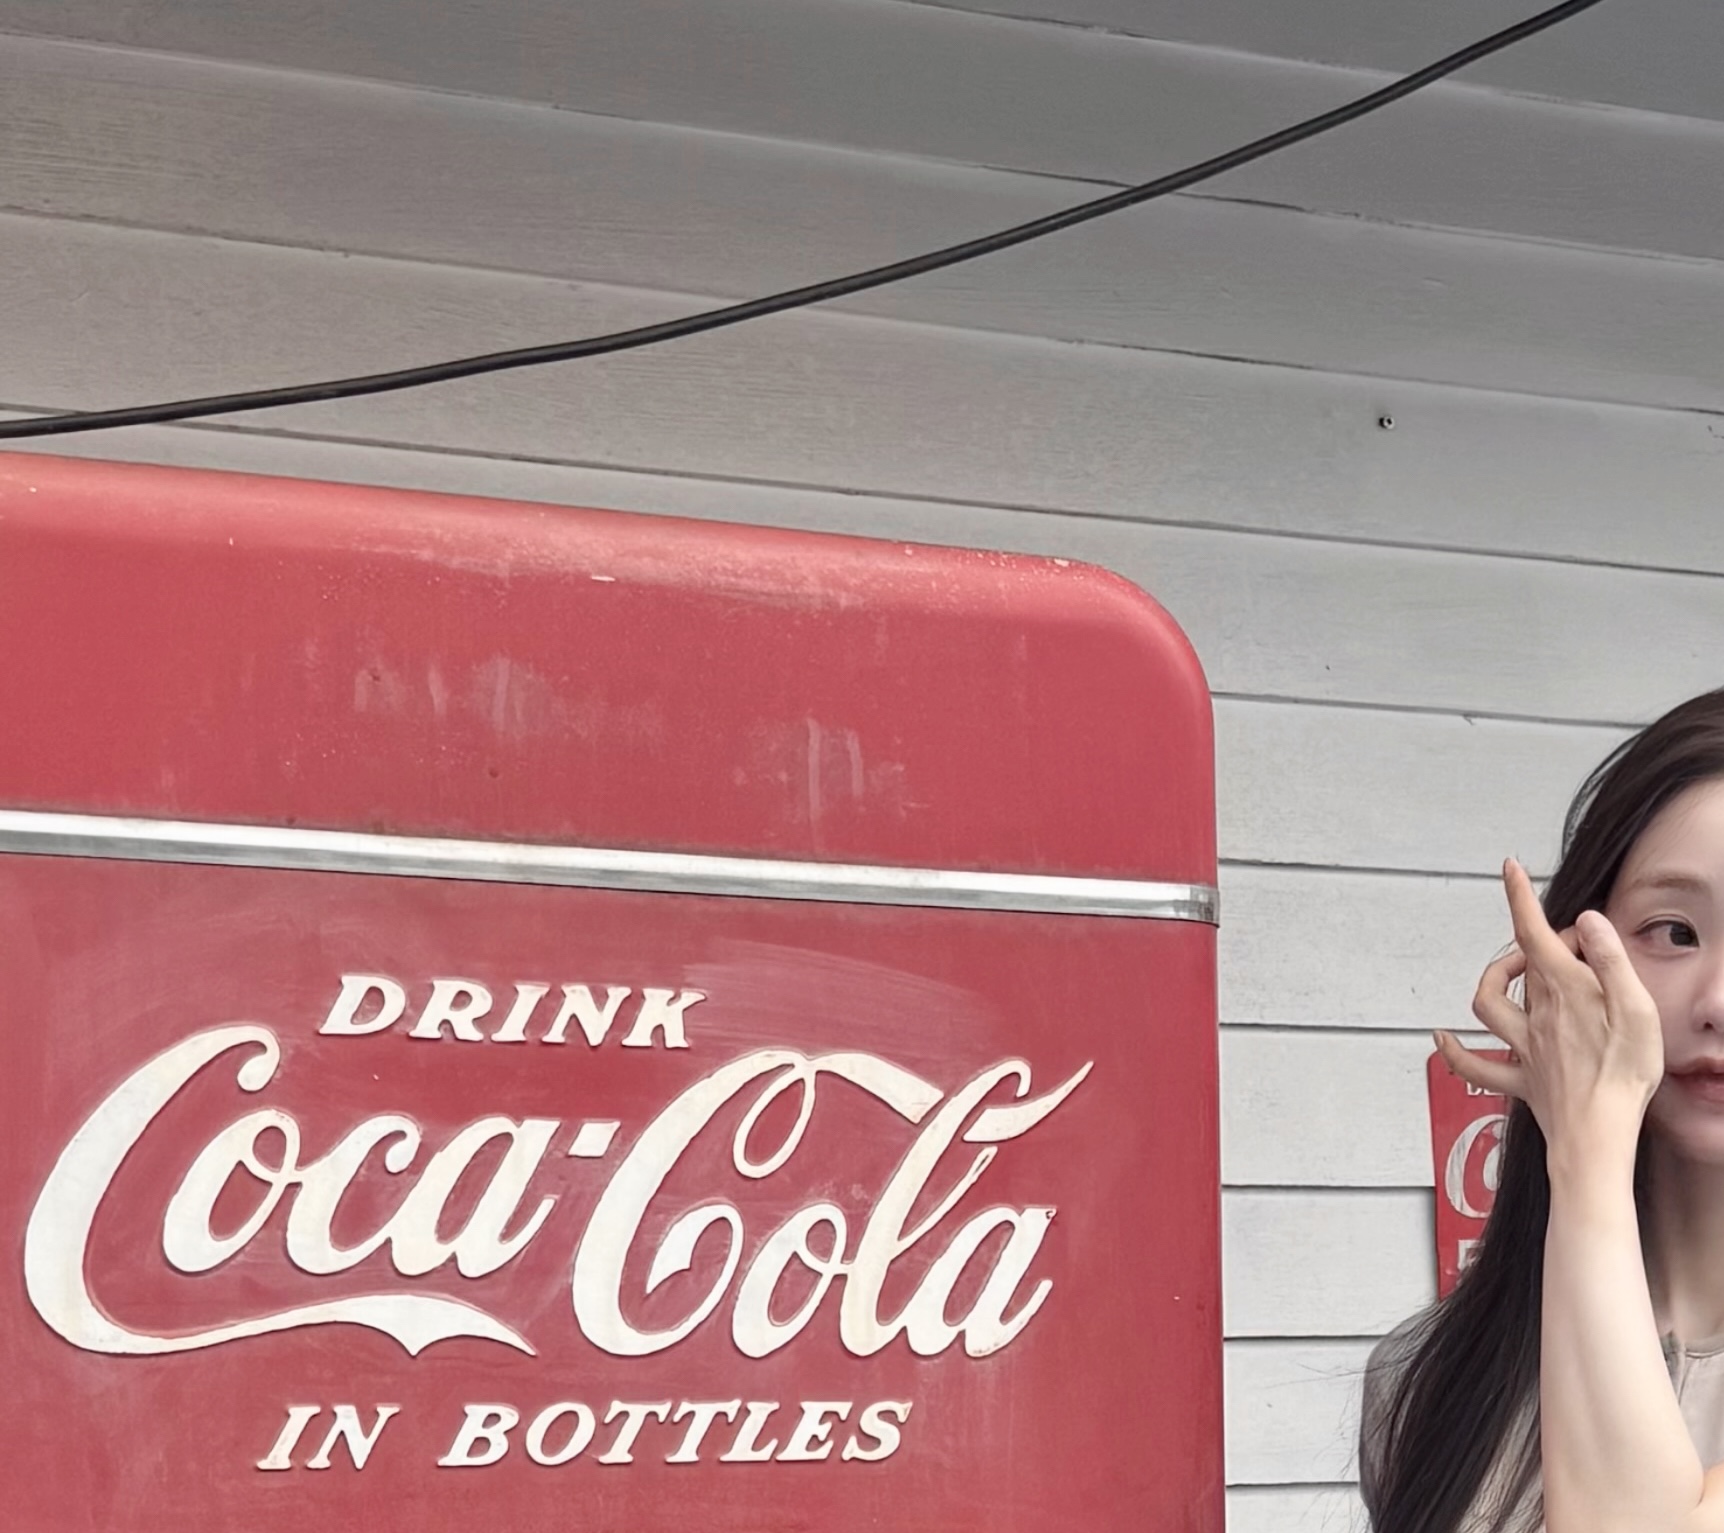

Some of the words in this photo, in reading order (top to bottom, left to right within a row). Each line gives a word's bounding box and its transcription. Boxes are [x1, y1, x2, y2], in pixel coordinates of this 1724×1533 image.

[318, 974, 707, 1050] DRINK
[24, 1024, 1094, 1358] Coca-Cola
[257, 1402, 400, 1471] IN
[438, 1400, 912, 1468] BOTTLES
